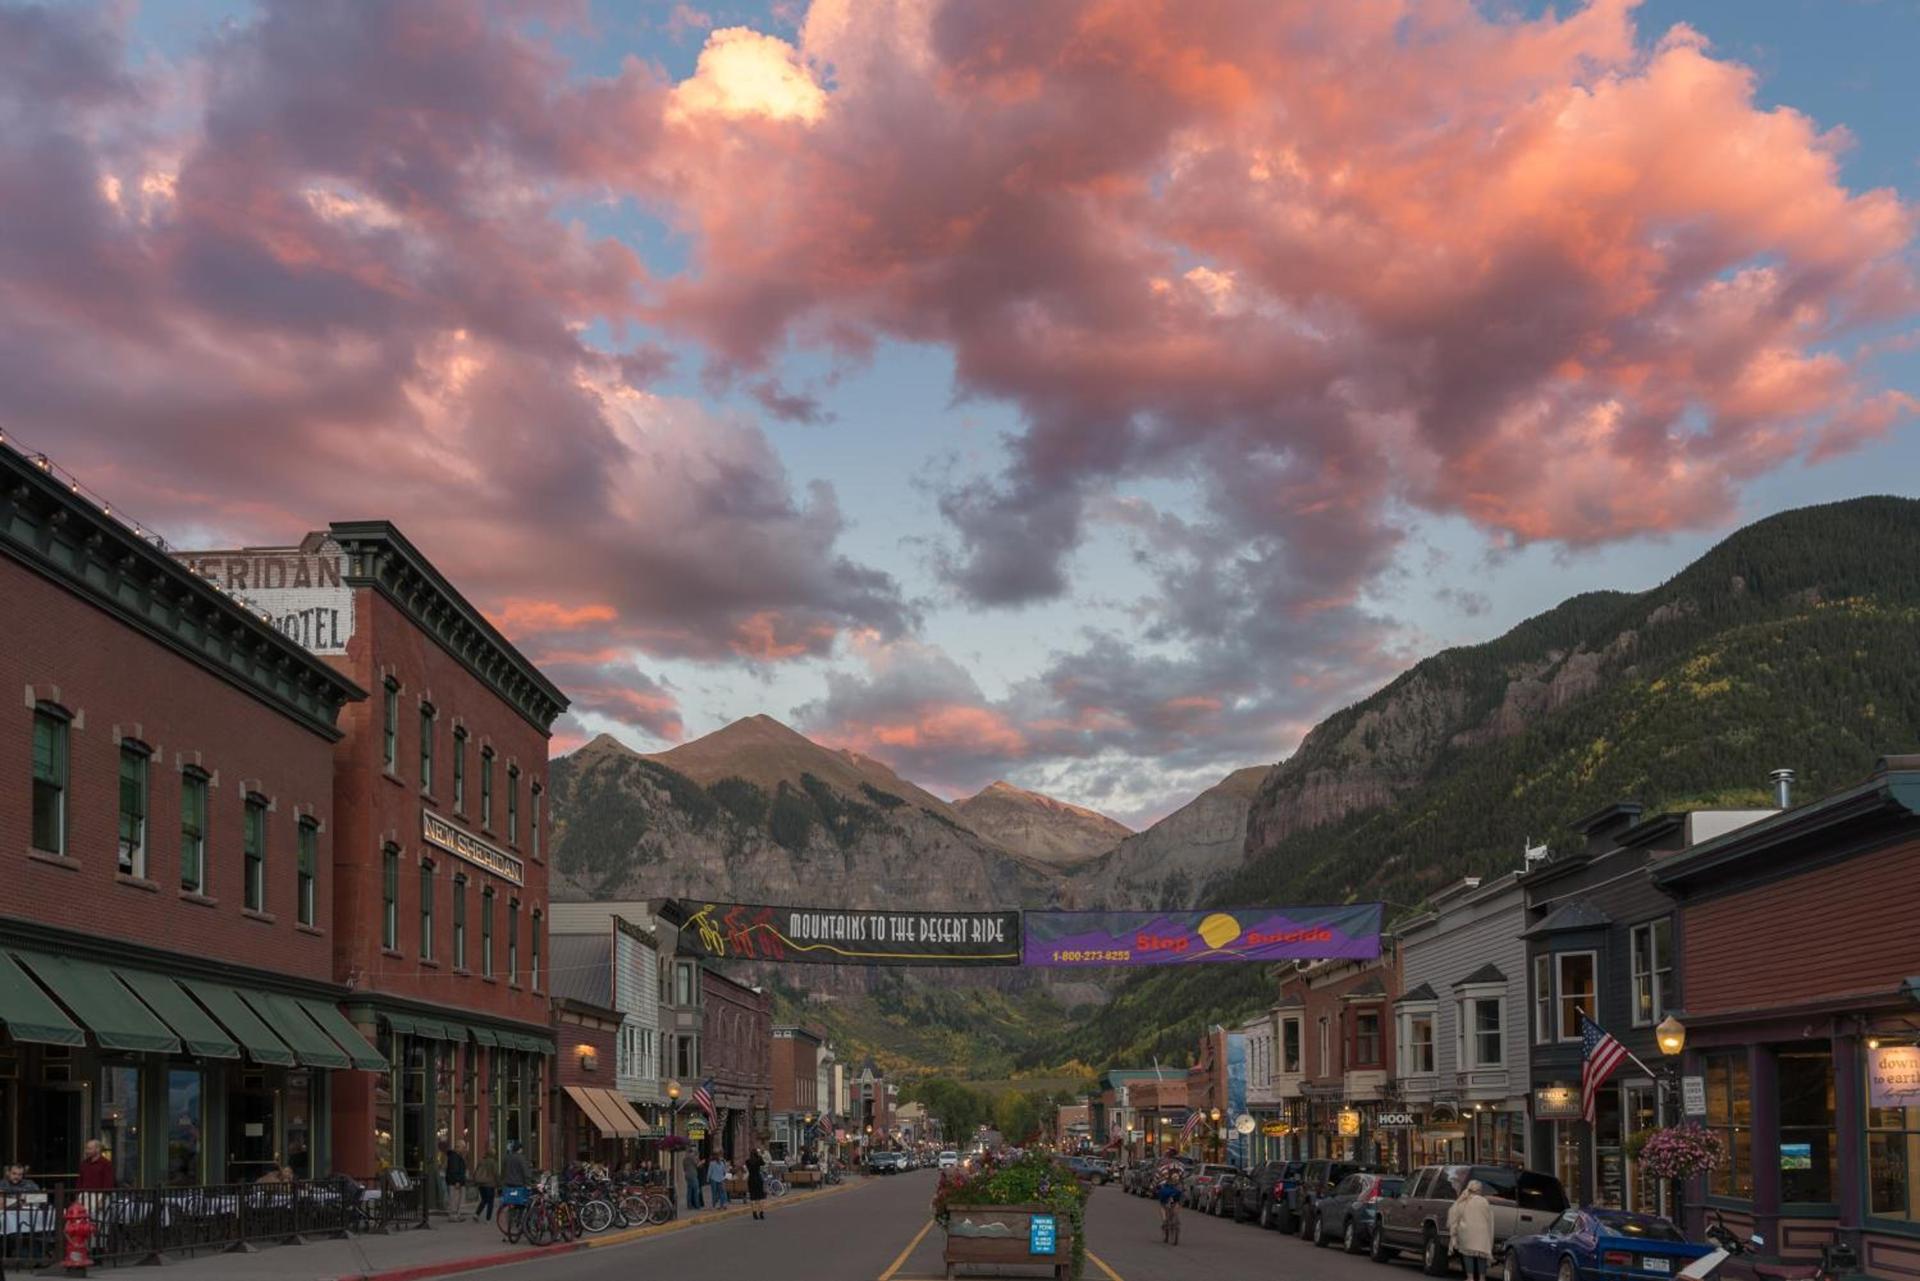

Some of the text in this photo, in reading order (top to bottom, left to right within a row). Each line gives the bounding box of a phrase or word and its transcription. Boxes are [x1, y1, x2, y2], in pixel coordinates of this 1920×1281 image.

[190, 556, 341, 589] ERIDAN
[424, 818, 521, 881] NEW SHERIDAN
[790, 913, 1004, 943] MOUNTAINS TO THE DESERT RIDE
[1136, 933, 1190, 953] Stop
[1879, 1058, 1920, 1069] down
[1379, 1114, 1414, 1124] HOOK
